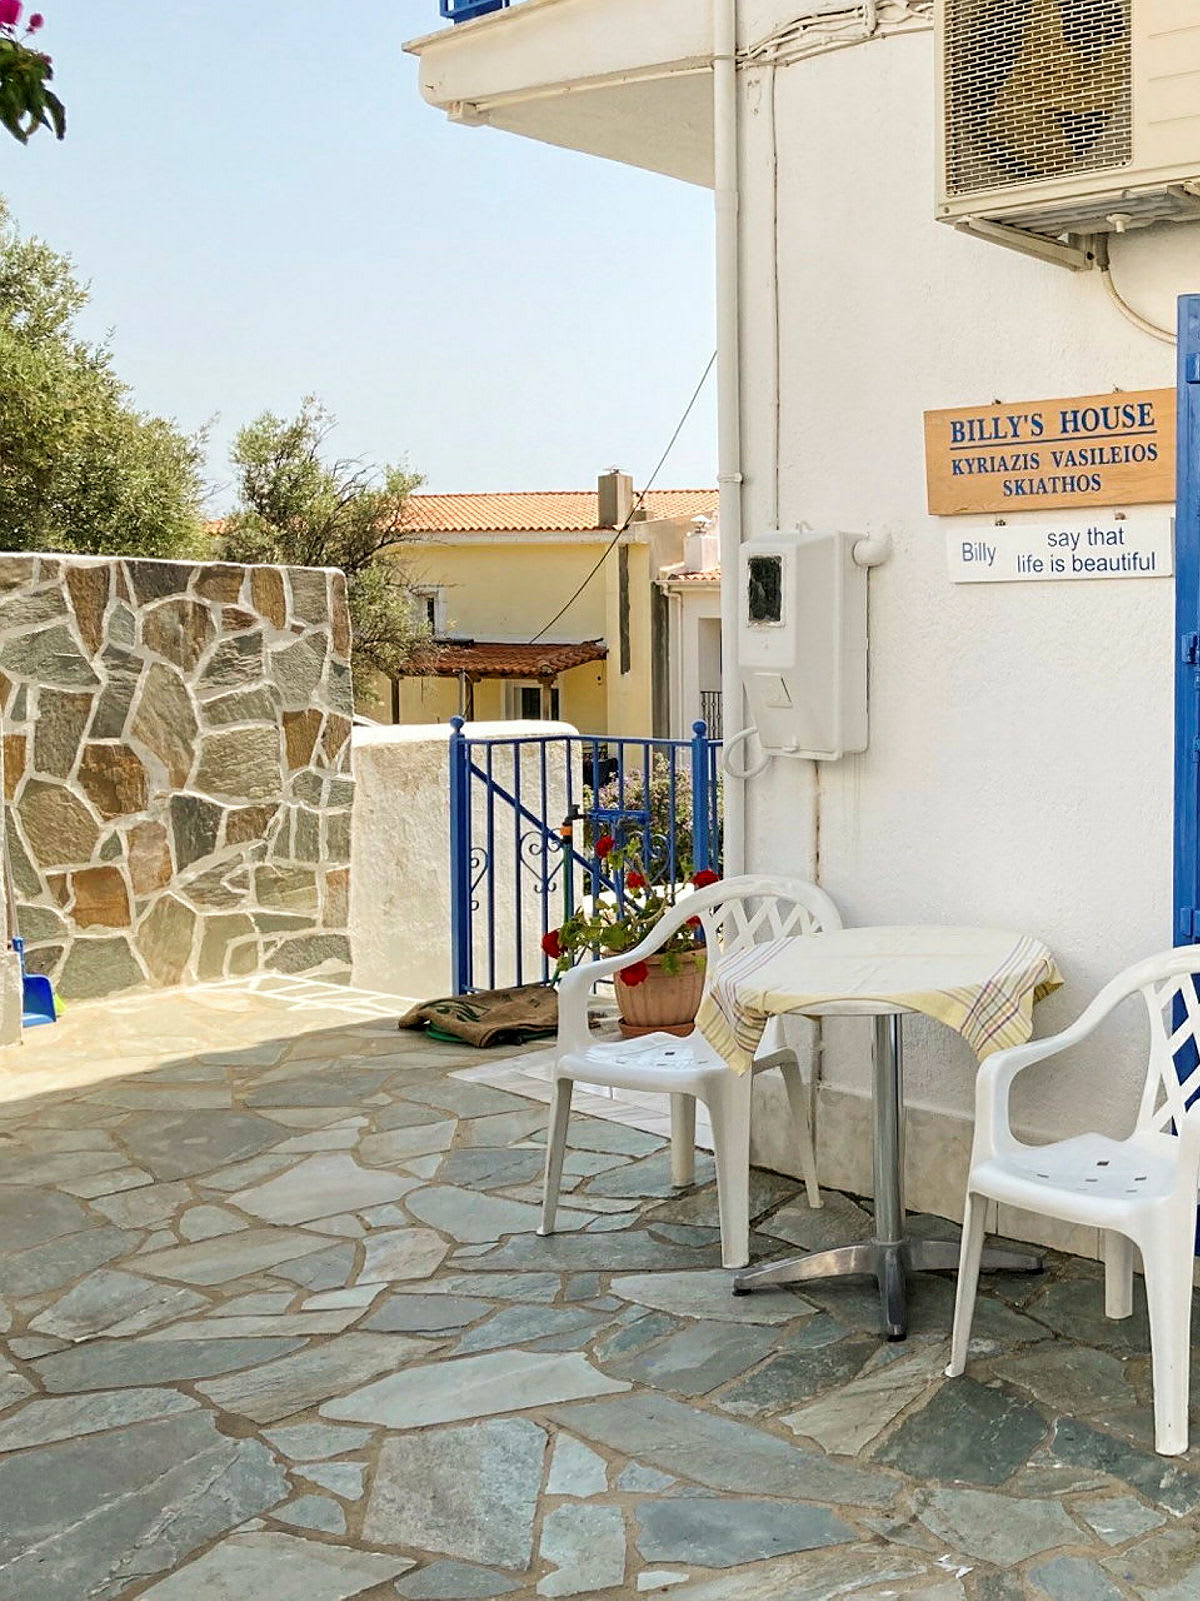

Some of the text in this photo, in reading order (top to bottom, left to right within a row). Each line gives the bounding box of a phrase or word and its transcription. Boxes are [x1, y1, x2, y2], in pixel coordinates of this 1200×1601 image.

[951, 403, 1155, 443] BILLY'S HOUSE
[951, 443, 1158, 475] KYRIAZIS VASILEIOS
[1003, 474, 1102, 497] SKIATHOS
[1047, 527, 1125, 551] say that
[962, 542, 997, 566] Billy
[1017, 552, 1156, 573] life is beautiful
